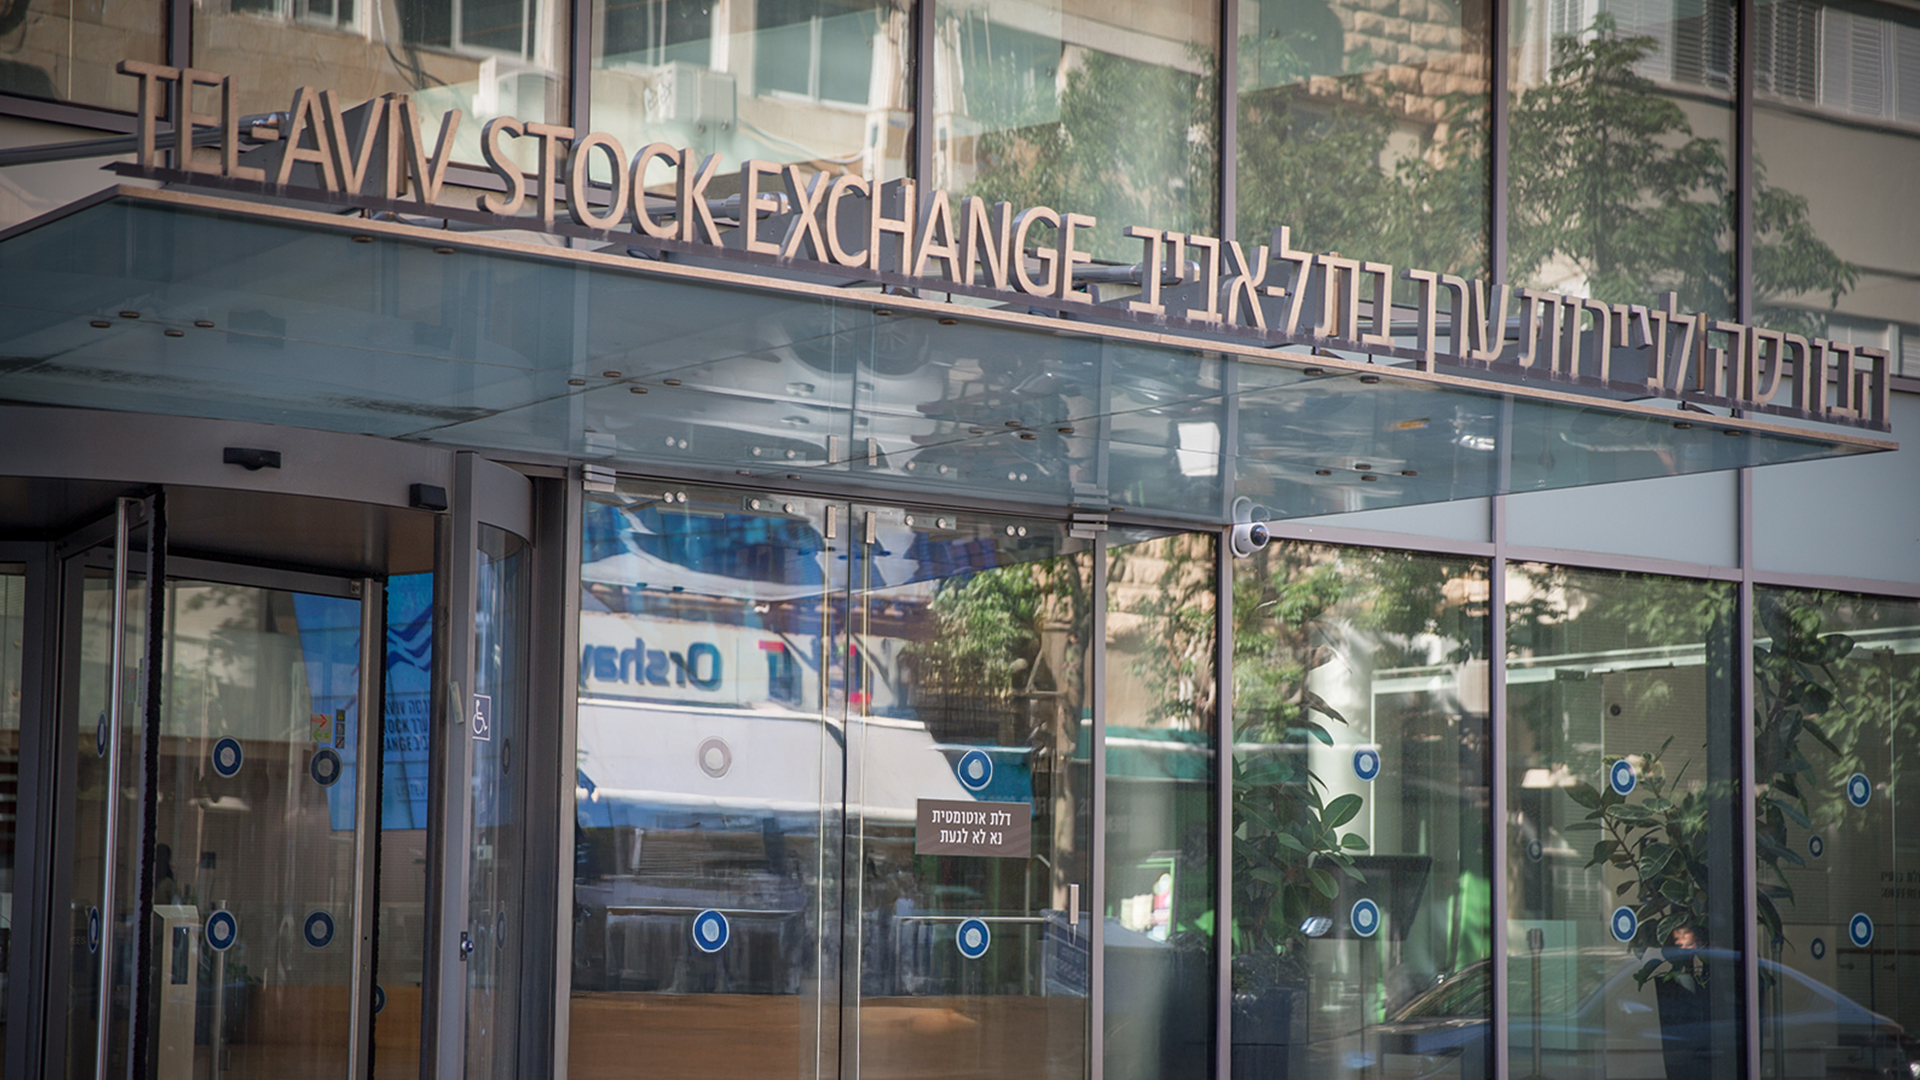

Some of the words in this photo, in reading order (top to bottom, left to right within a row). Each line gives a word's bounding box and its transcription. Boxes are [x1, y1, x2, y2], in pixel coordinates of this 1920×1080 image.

[116, 59, 462, 205] TEL-AVIV
[476, 115, 723, 248] STOCK
[740, 158, 1097, 304] EXCHANGE
[1123, 225, 1394, 348] בתל-אביב
[1401, 267, 1510, 373] ערך
[1513, 287, 1697, 395] לניירות
[1706, 319, 1891, 427] הבורסה
[931, 809, 986, 826] אוטומטית
[939, 827, 969, 845] לגעת
[972, 828, 986, 845] לא
[989, 810, 1011, 826] דלת
[989, 831, 1003, 845] נא
